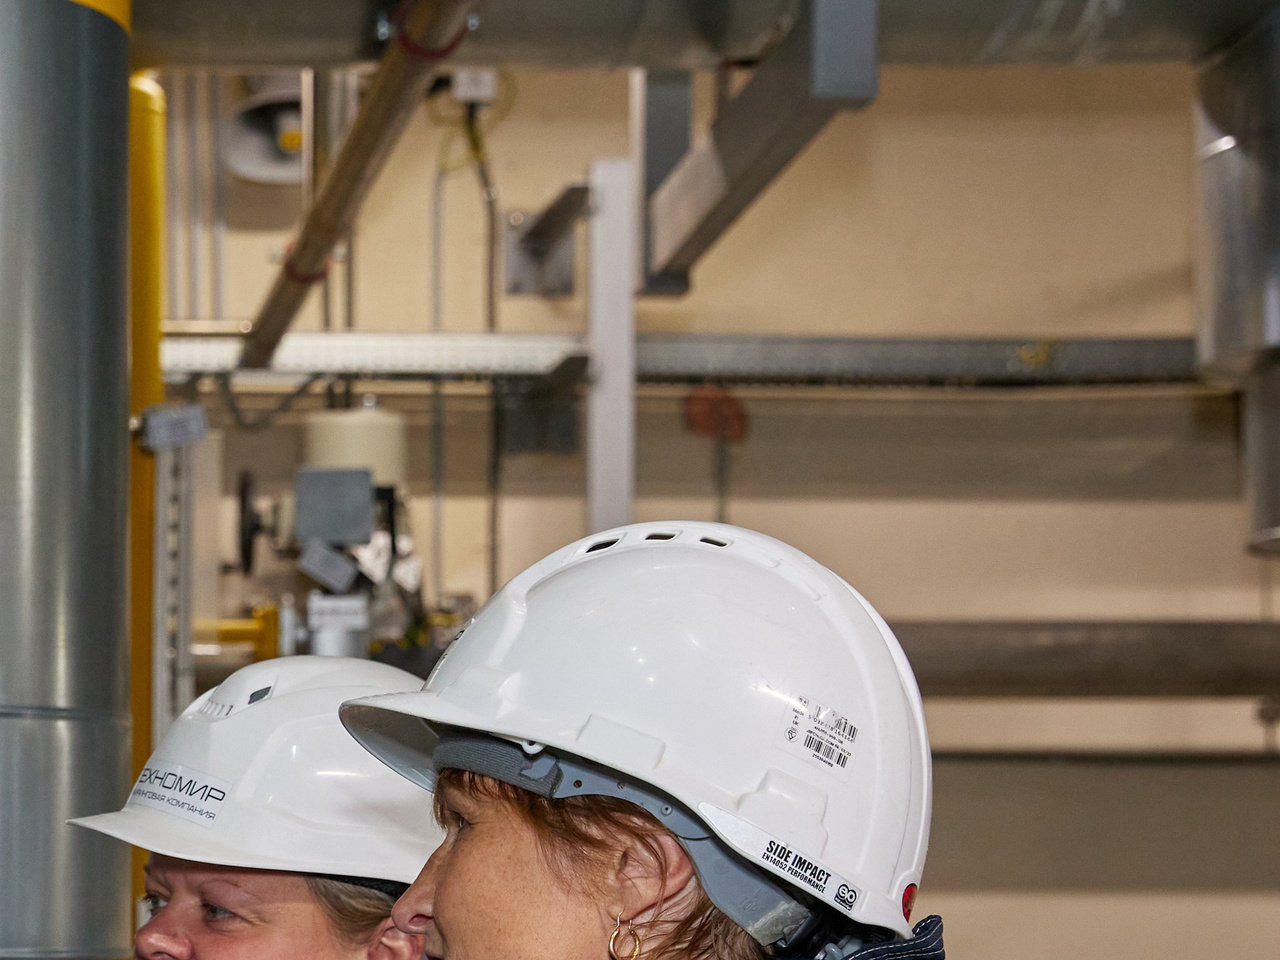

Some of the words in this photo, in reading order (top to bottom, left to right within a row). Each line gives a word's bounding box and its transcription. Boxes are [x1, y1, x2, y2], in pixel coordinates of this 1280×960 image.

[166, 798, 217, 821] КОМПАНИЯ
[761, 852, 788, 872] EN14052
[786, 866, 826, 894] PERFORMANCE
[766, 840, 793, 863] SIDE
[791, 853, 832, 886] IMPACT
